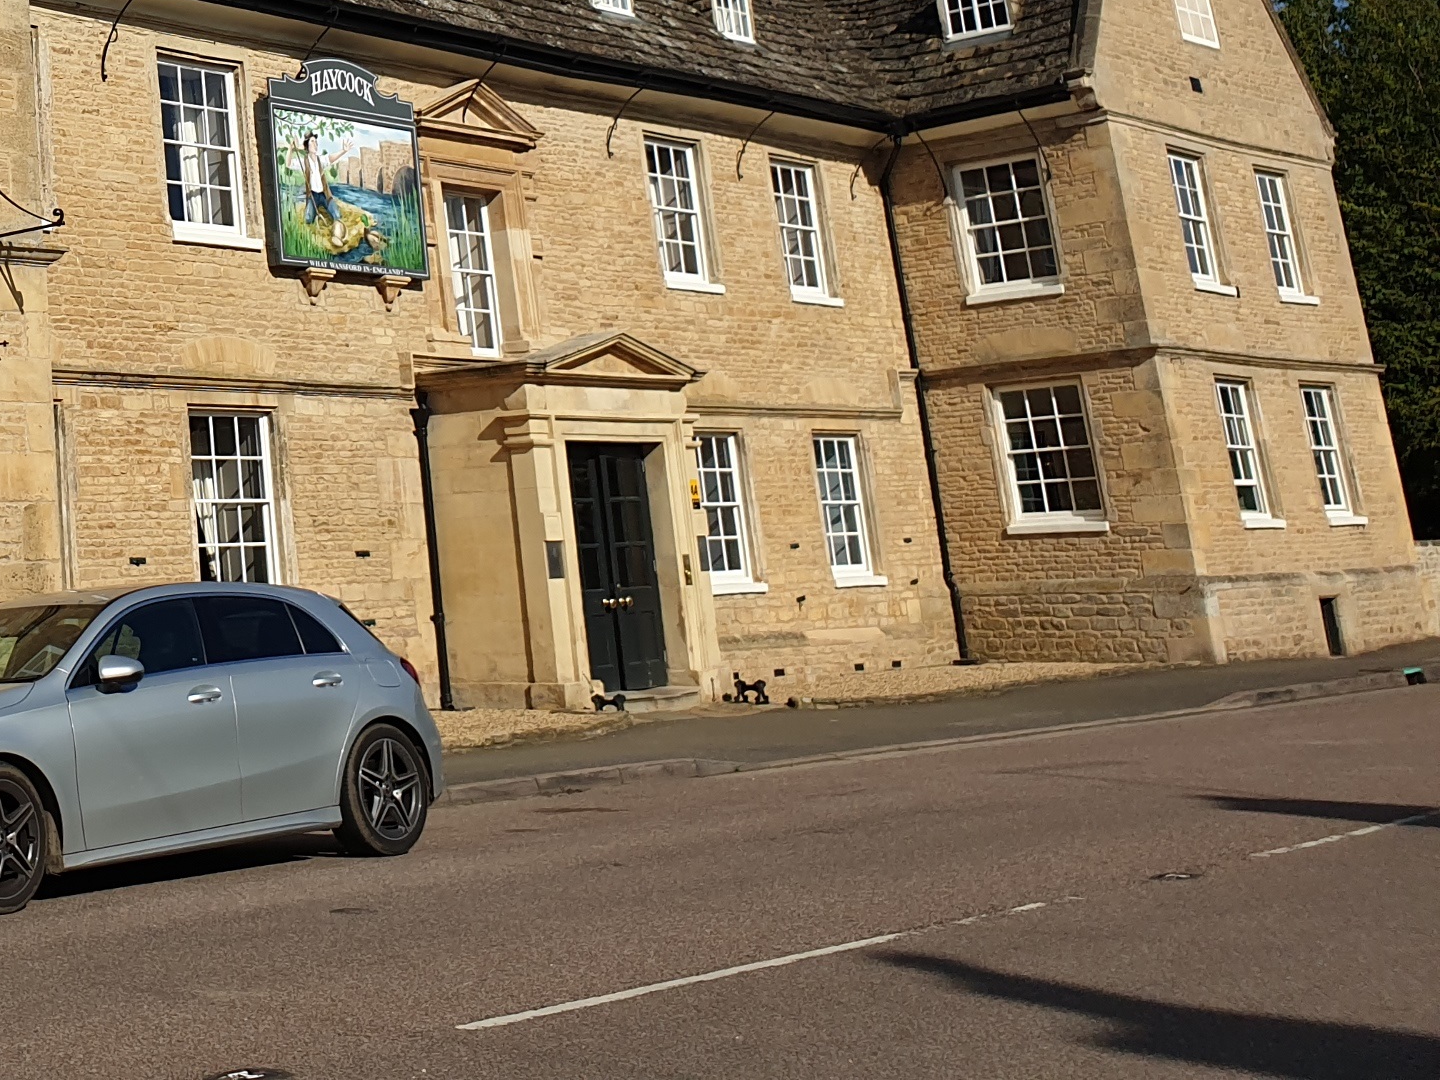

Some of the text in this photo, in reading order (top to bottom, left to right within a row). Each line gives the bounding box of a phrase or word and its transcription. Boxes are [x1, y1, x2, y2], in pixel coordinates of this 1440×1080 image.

[310, 69, 375, 107] HAYCOCK
[309, 260, 328, 268] WHAT
[329, 262, 362, 272] WANSFORD
